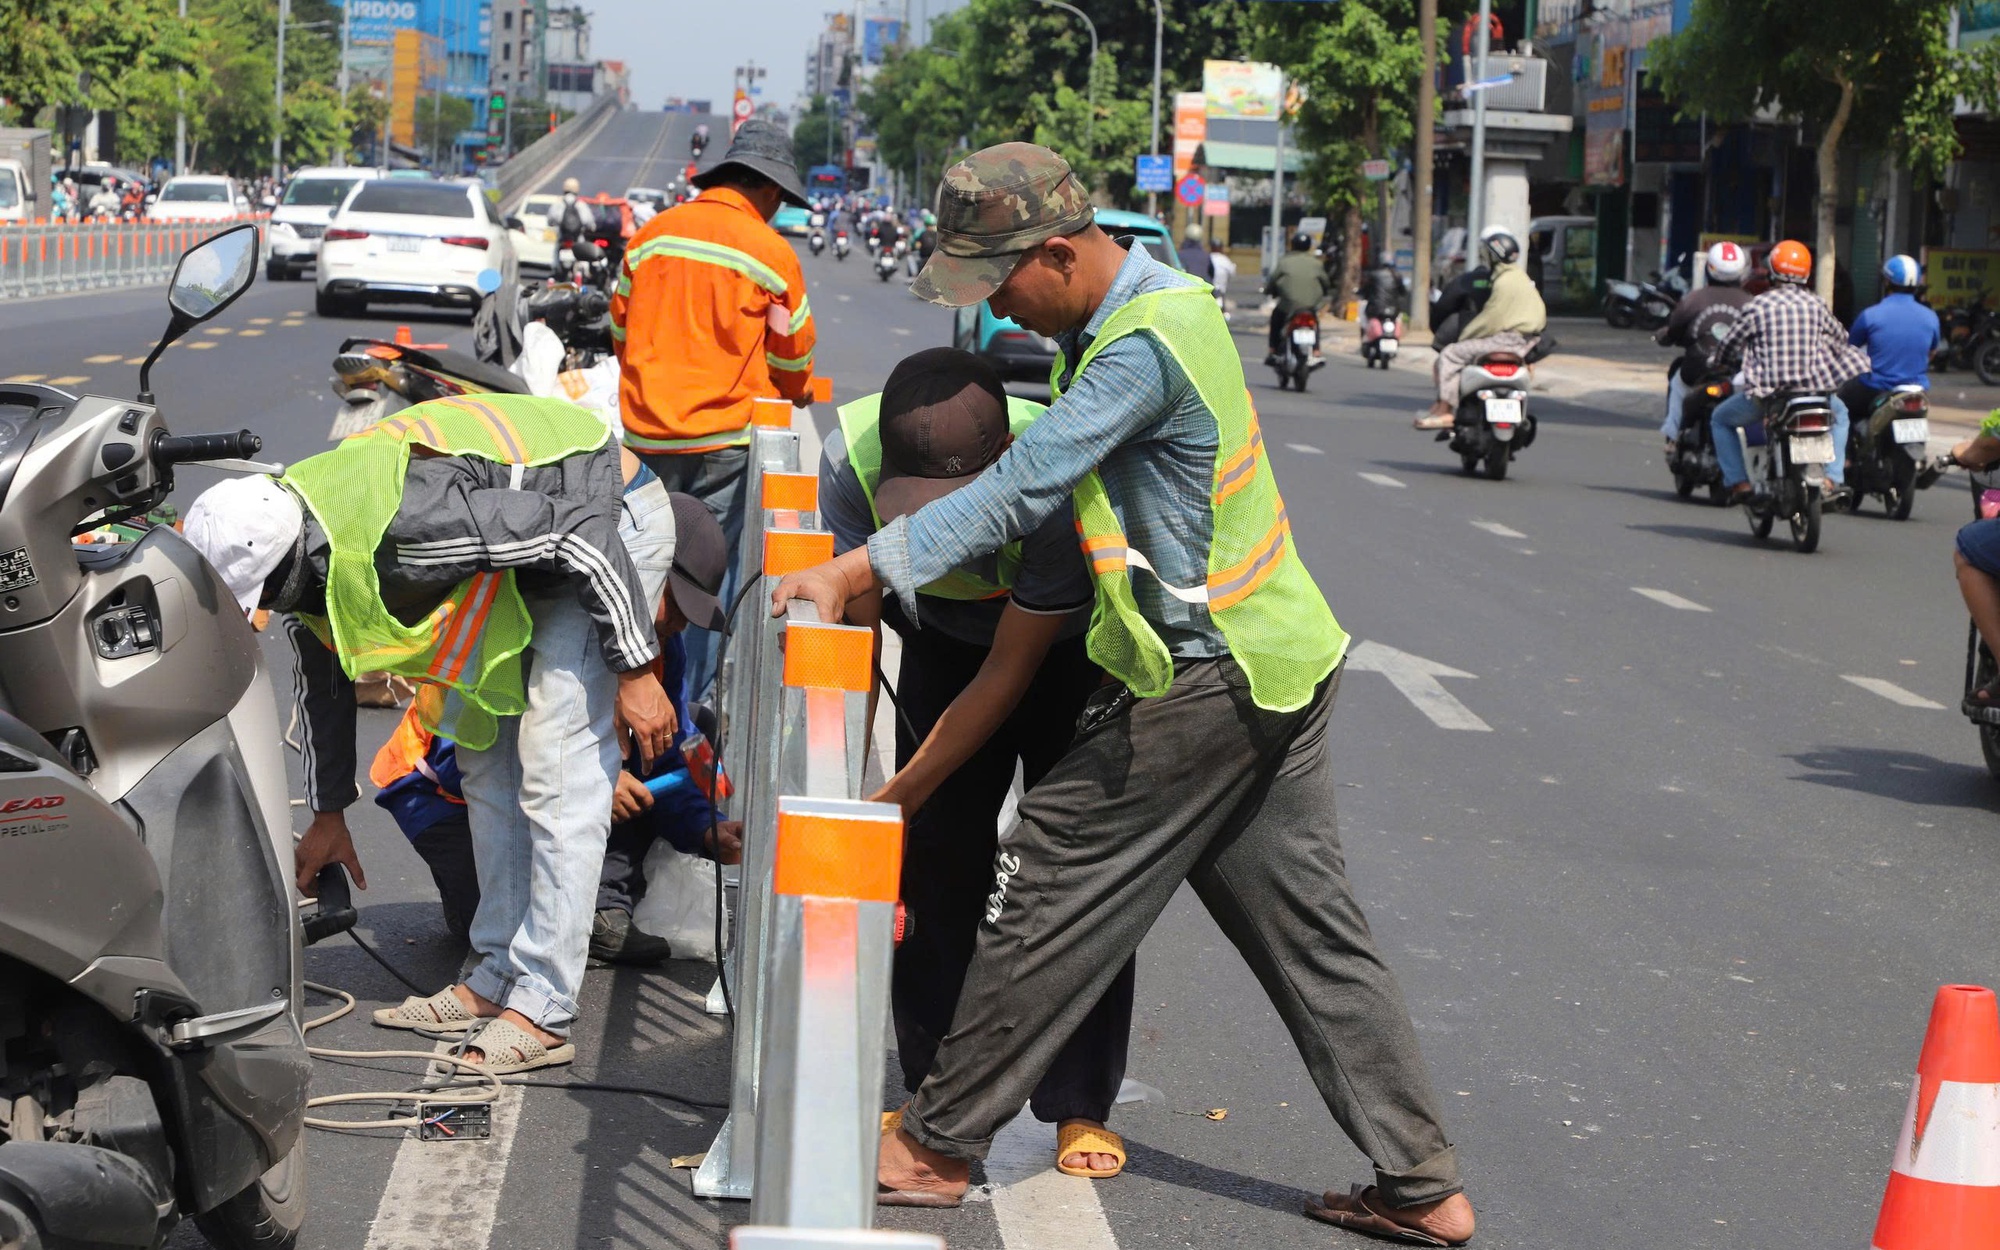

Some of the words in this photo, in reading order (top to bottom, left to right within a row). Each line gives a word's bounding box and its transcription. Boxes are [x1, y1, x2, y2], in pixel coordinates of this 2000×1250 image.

[0, 795, 66, 814] EAD
[0, 822, 46, 838] PECIAL
[985, 852, 1021, 925] Design
